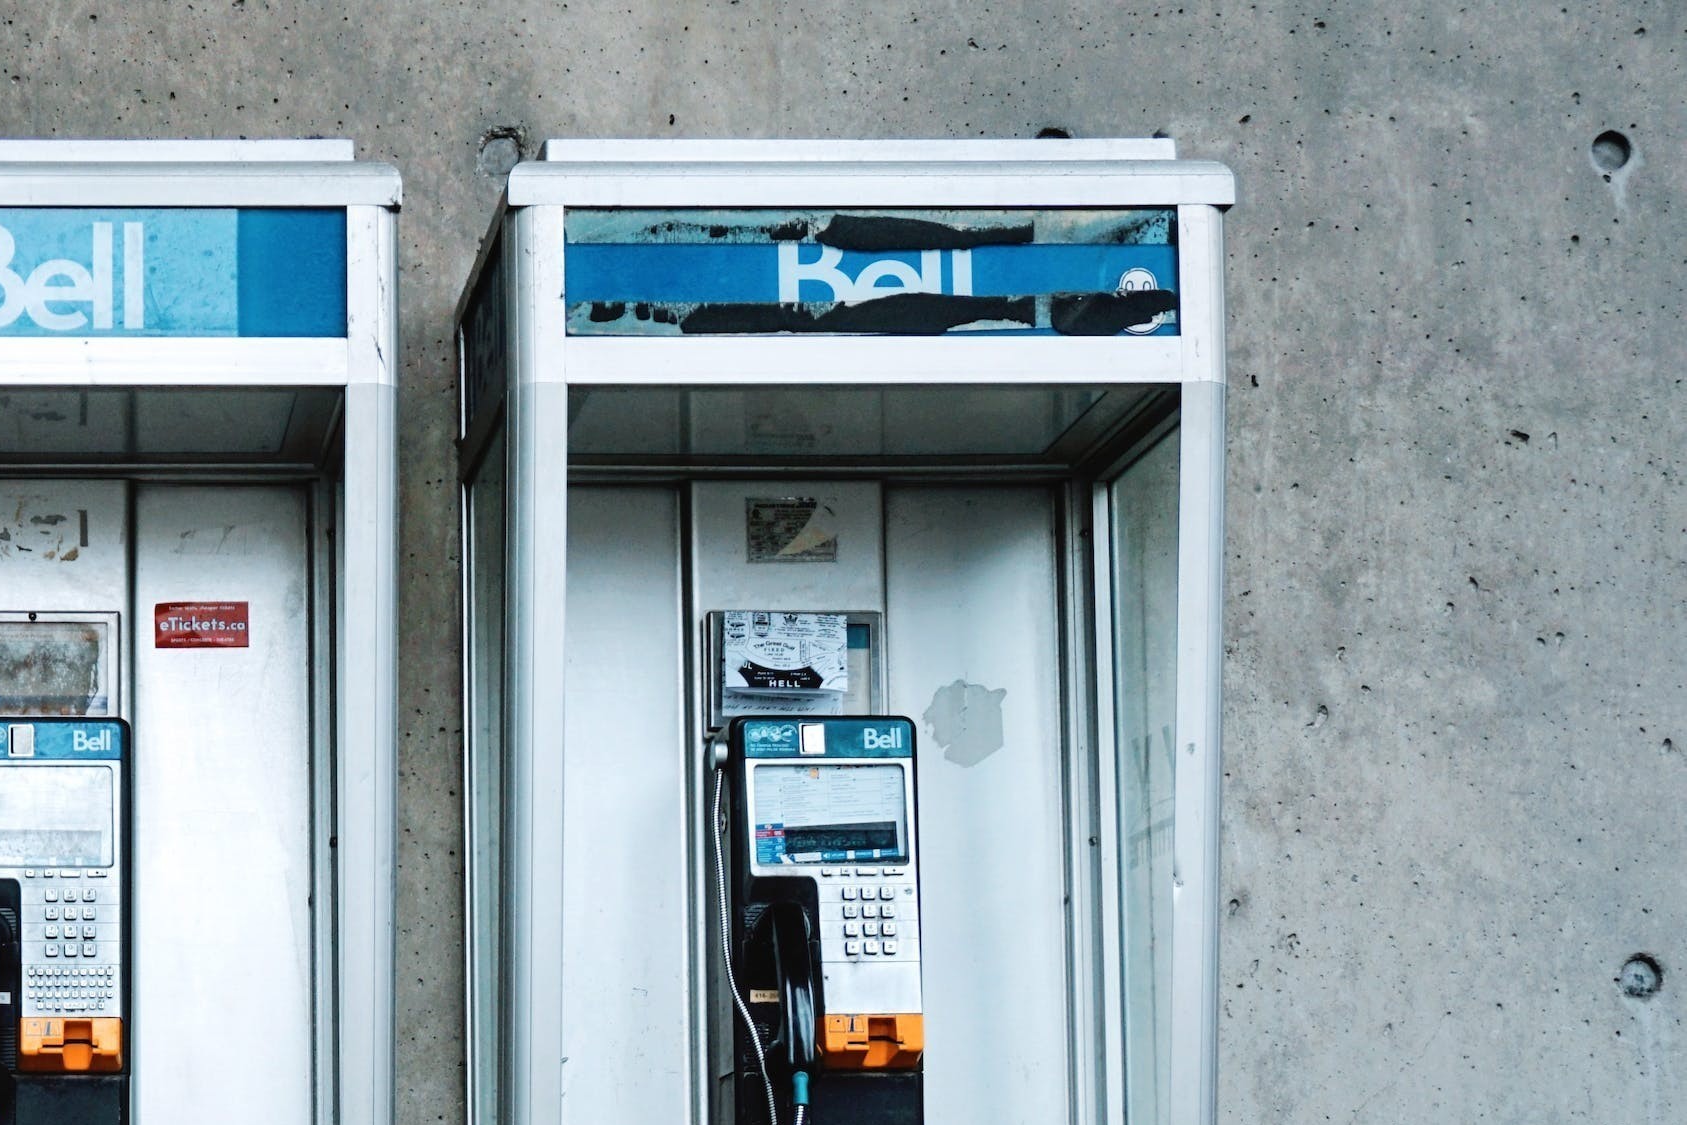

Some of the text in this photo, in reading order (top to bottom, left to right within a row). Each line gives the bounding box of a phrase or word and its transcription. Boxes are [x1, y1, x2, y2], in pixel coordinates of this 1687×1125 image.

[778, 243, 973, 308] Bell
[159, 616, 245, 631] eTickets.ca
[768, 680, 801, 688] HELL
[72, 729, 111, 751] Bell
[863, 727, 902, 749] Bell
